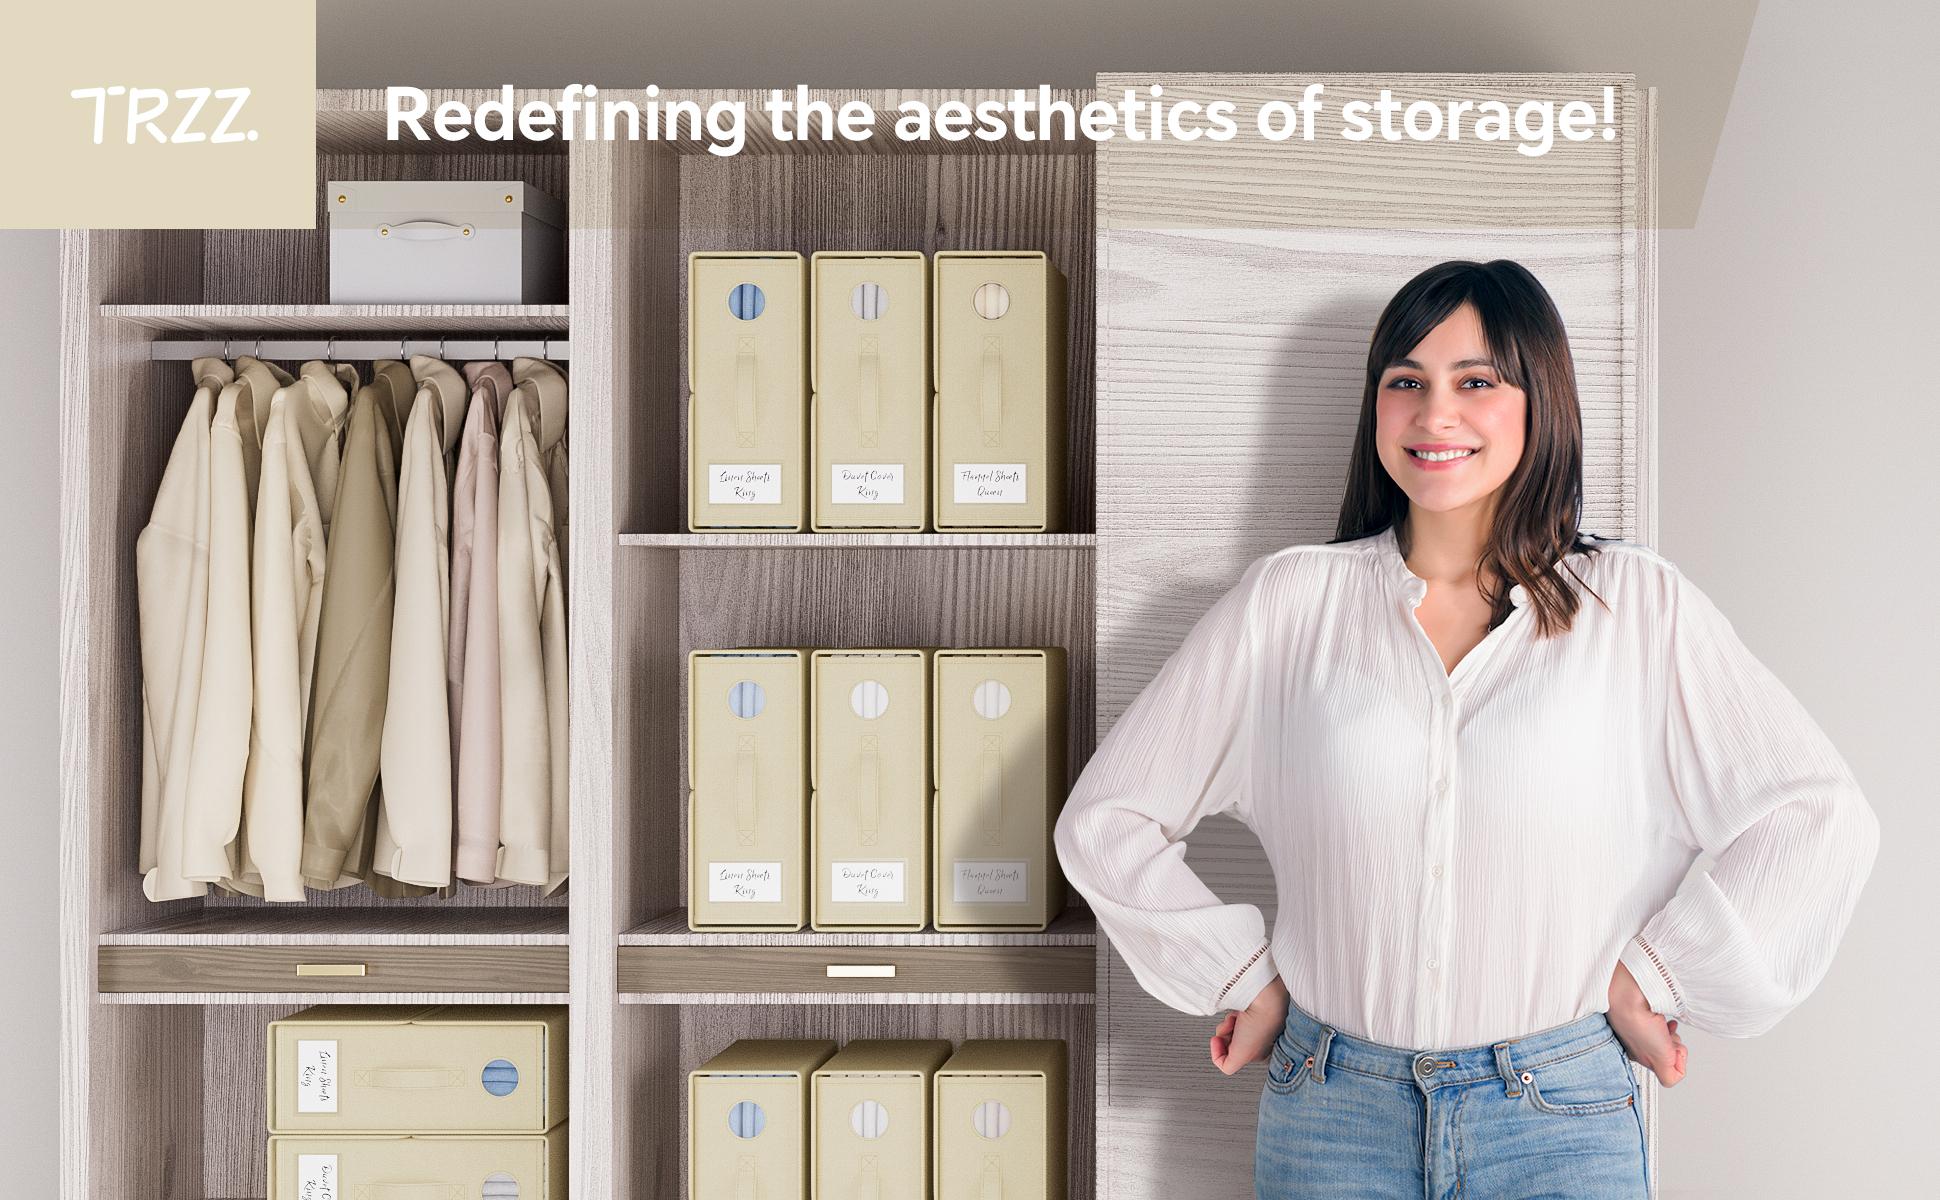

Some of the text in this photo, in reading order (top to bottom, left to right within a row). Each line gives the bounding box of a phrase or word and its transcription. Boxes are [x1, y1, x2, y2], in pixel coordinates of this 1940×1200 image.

[733, 486, 756, 501] King
[856, 485, 879, 501] King
[734, 883, 756, 898] King
[856, 883, 879, 898] King
